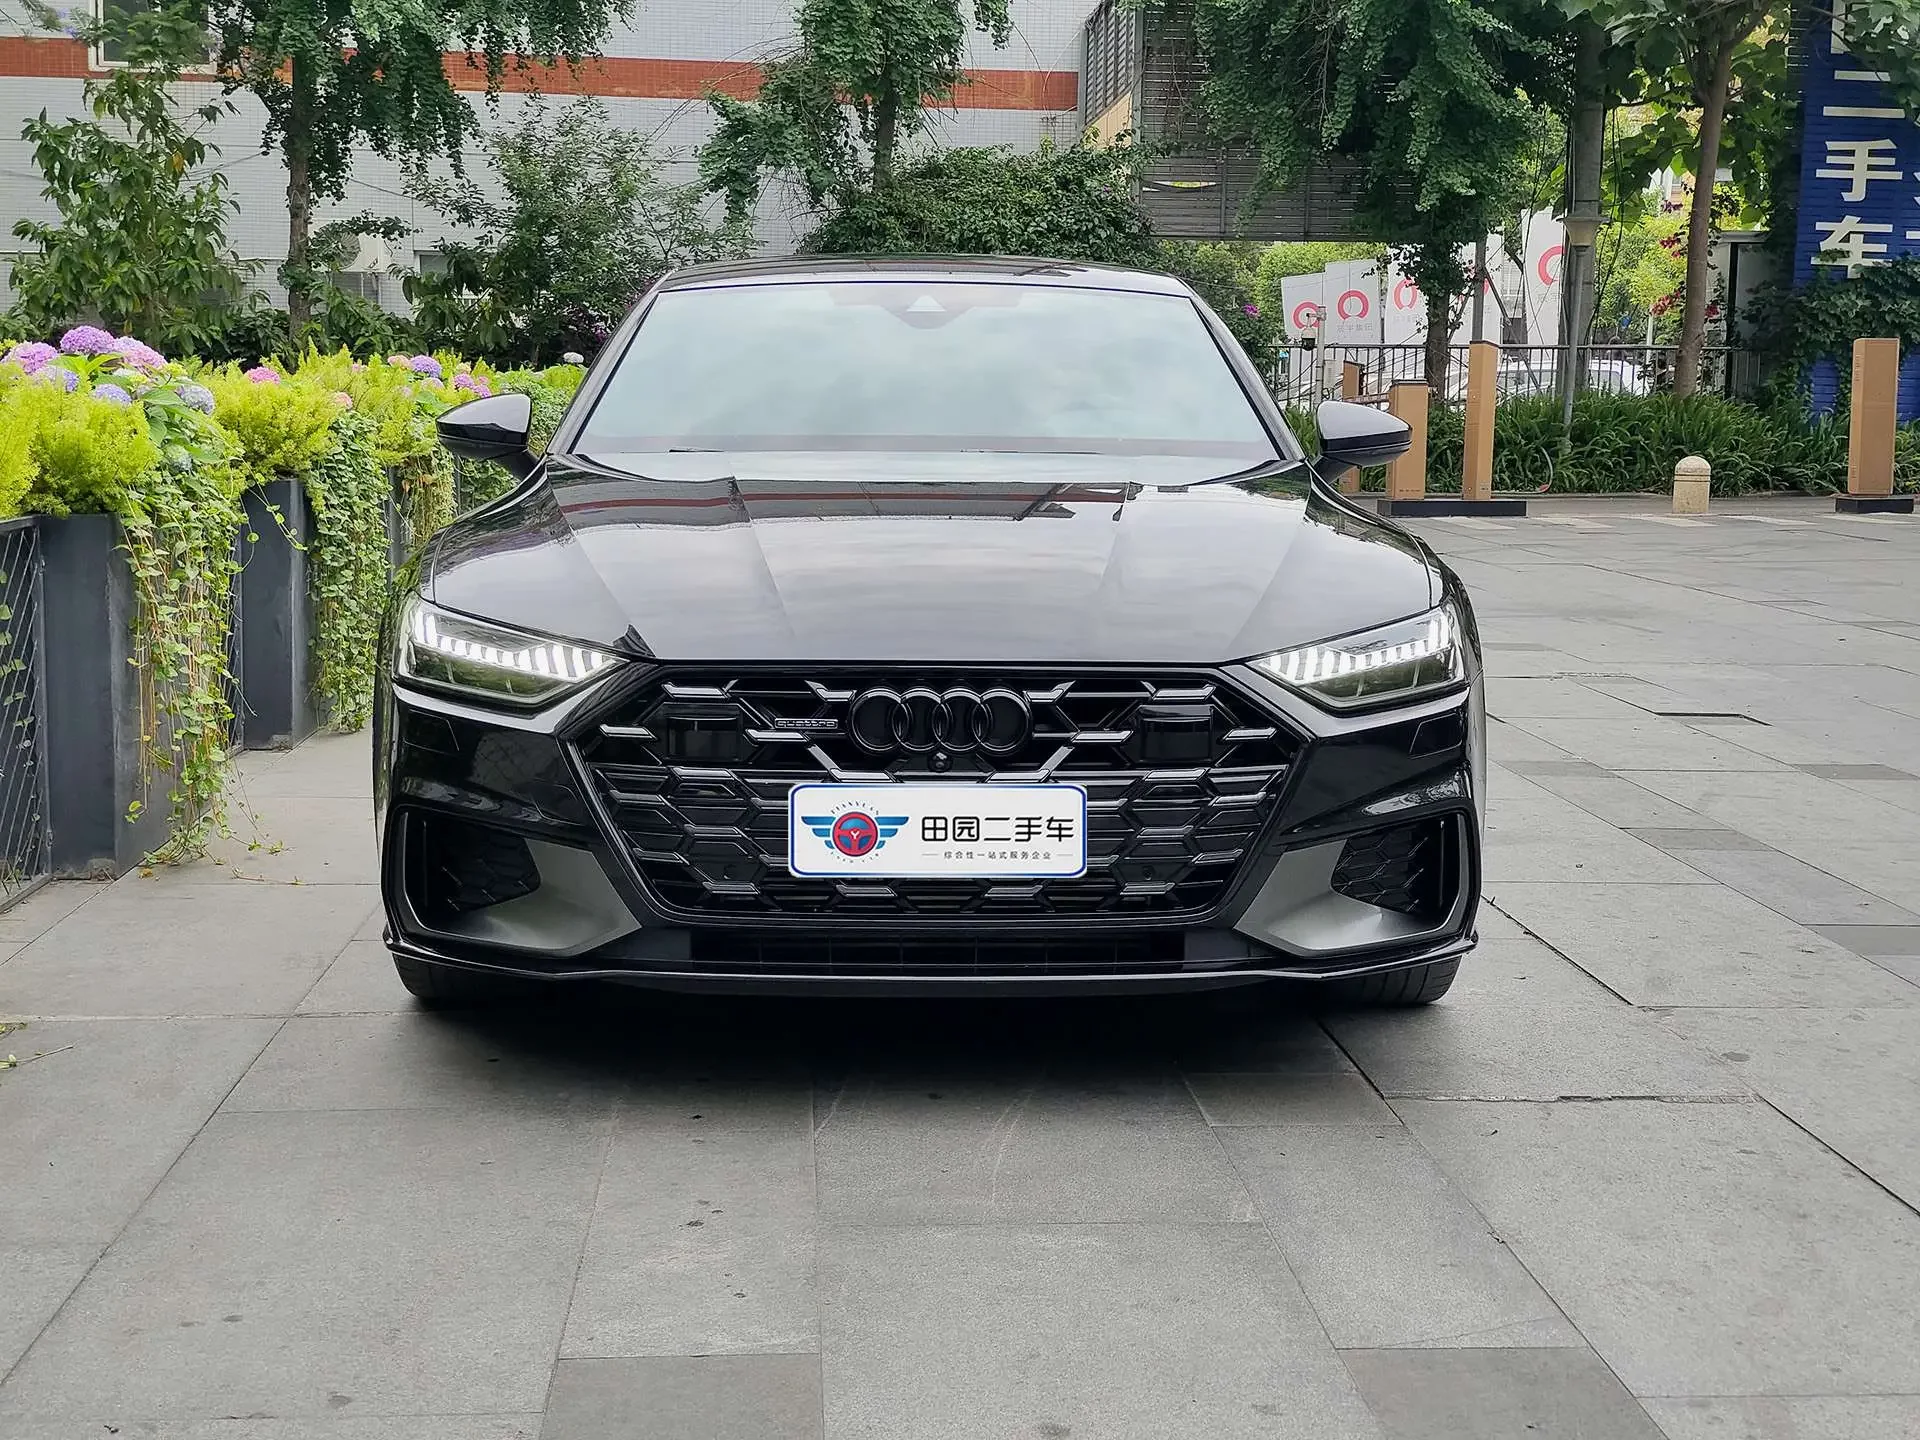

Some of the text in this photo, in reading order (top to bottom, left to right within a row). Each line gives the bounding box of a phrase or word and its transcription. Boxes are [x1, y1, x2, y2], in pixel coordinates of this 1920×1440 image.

[921, 816, 1075, 842] 田园二手车
[943, 851, 1052, 860] 综合性一站式服务企业
